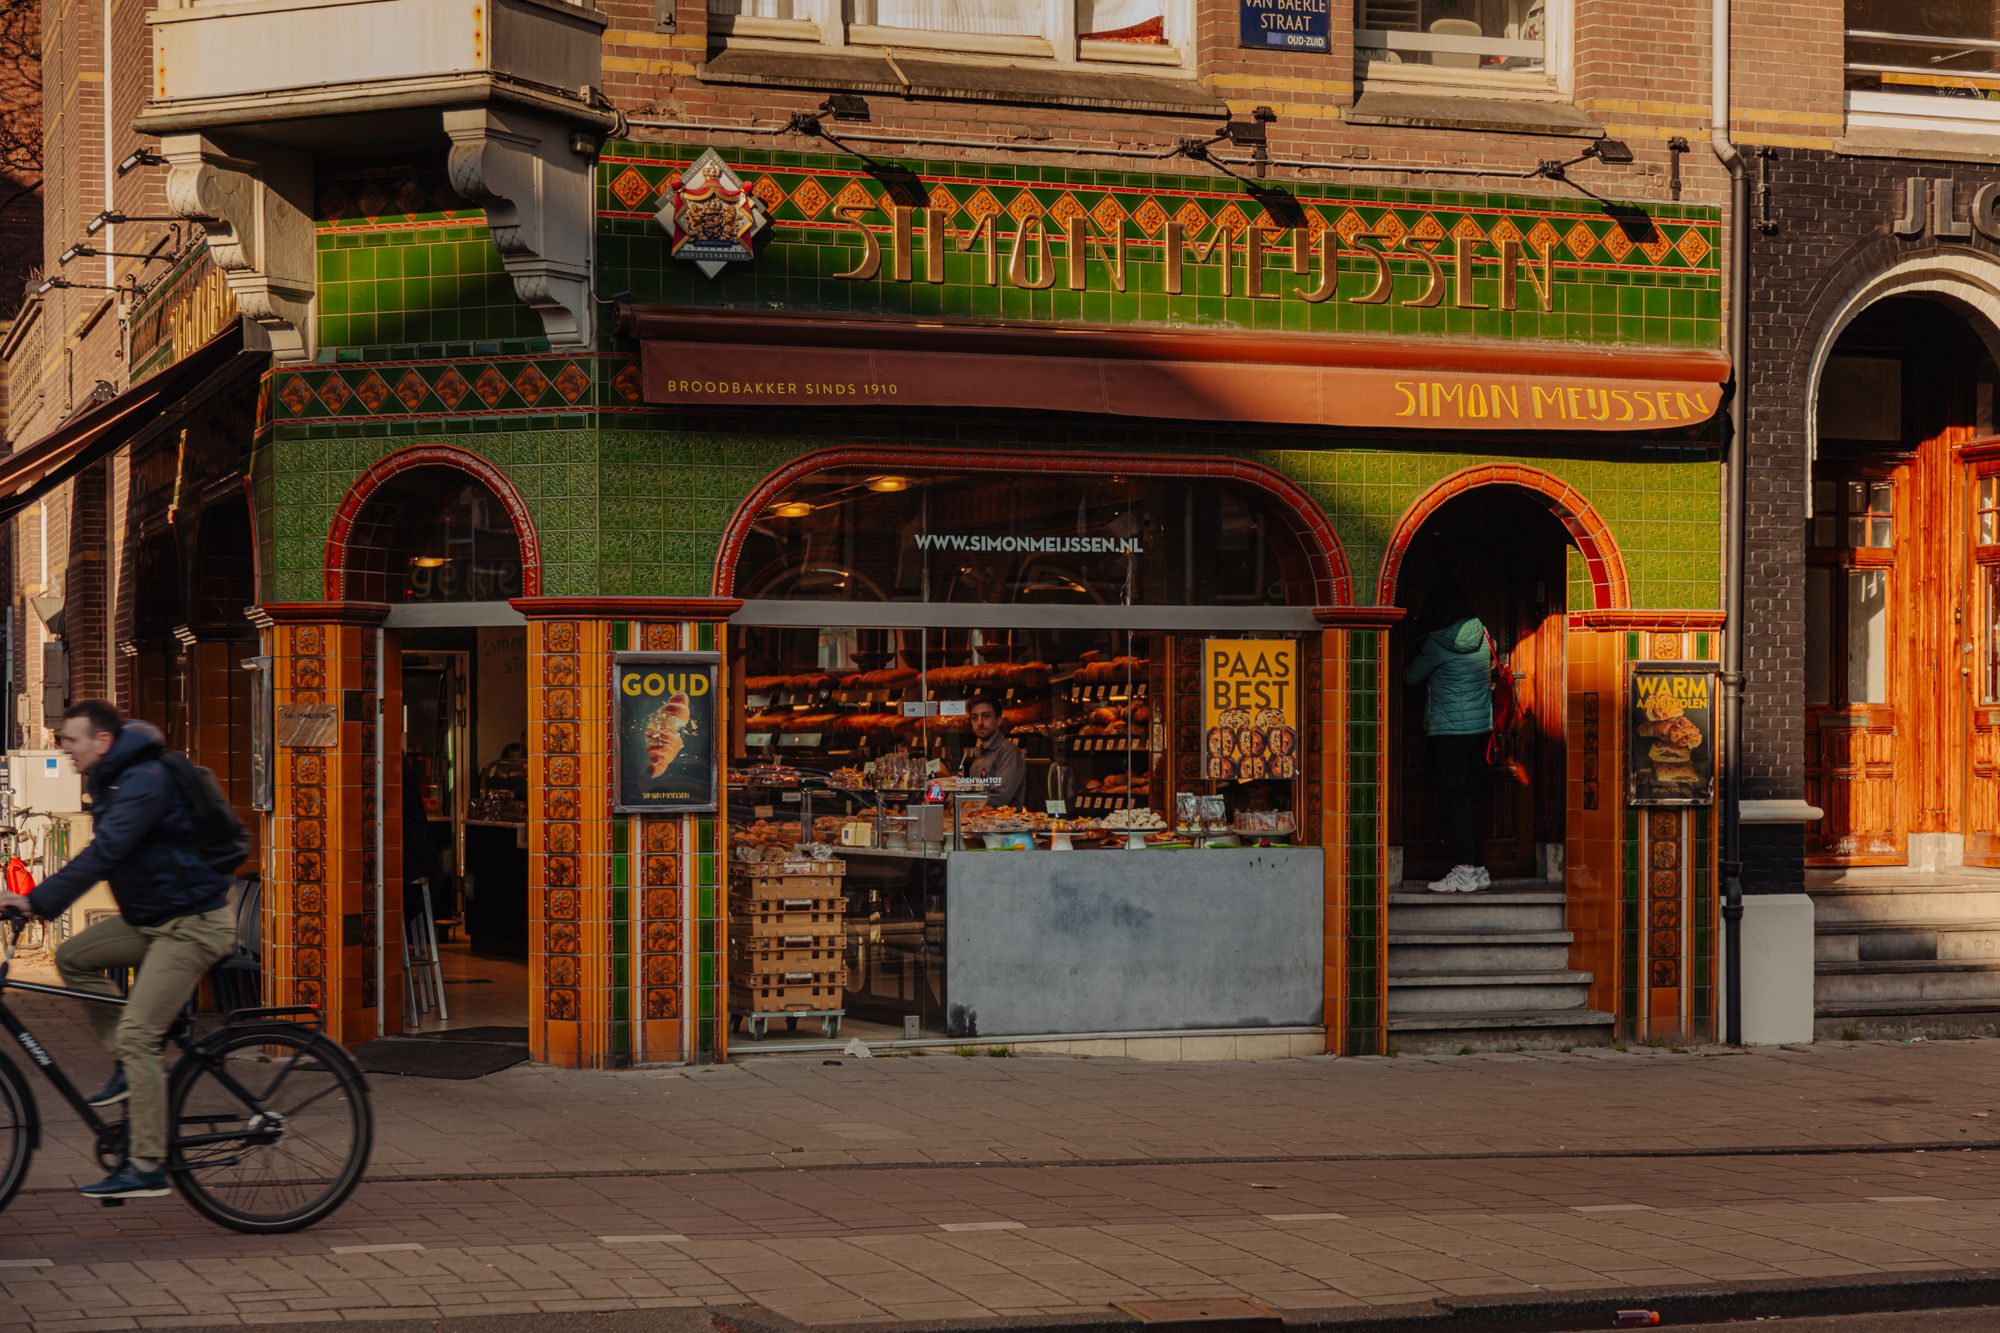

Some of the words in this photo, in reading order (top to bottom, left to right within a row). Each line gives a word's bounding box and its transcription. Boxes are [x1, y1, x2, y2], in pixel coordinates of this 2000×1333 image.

[1278, 0, 1326, 13] BAERLE
[1261, 13, 1312, 31] STRAAT
[1287, 35, 1325, 47] OUD-ZUID
[680, 251, 746, 260] HOFLEVERANCIER
[832, 203, 1126, 293] SIMON
[1165, 221, 1553, 313] MEIJSSEN
[667, 380, 798, 395] BROODBAKKER
[805, 383, 857, 395] SINDS
[863, 383, 898, 395] 1910
[1394, 382, 1520, 419] SIMON
[1531, 386, 1710, 422] MEIJSSEN
[914, 534, 1144, 553] WWW.SIMONMEIJSSEN.NL
[1213, 650, 1290, 678] PAAS
[622, 672, 709, 697] GOUD
[1636, 676, 1707, 698] WARM
[1213, 680, 1290, 710] BEST
[1636, 698, 1708, 709] AANBEVOLEN
